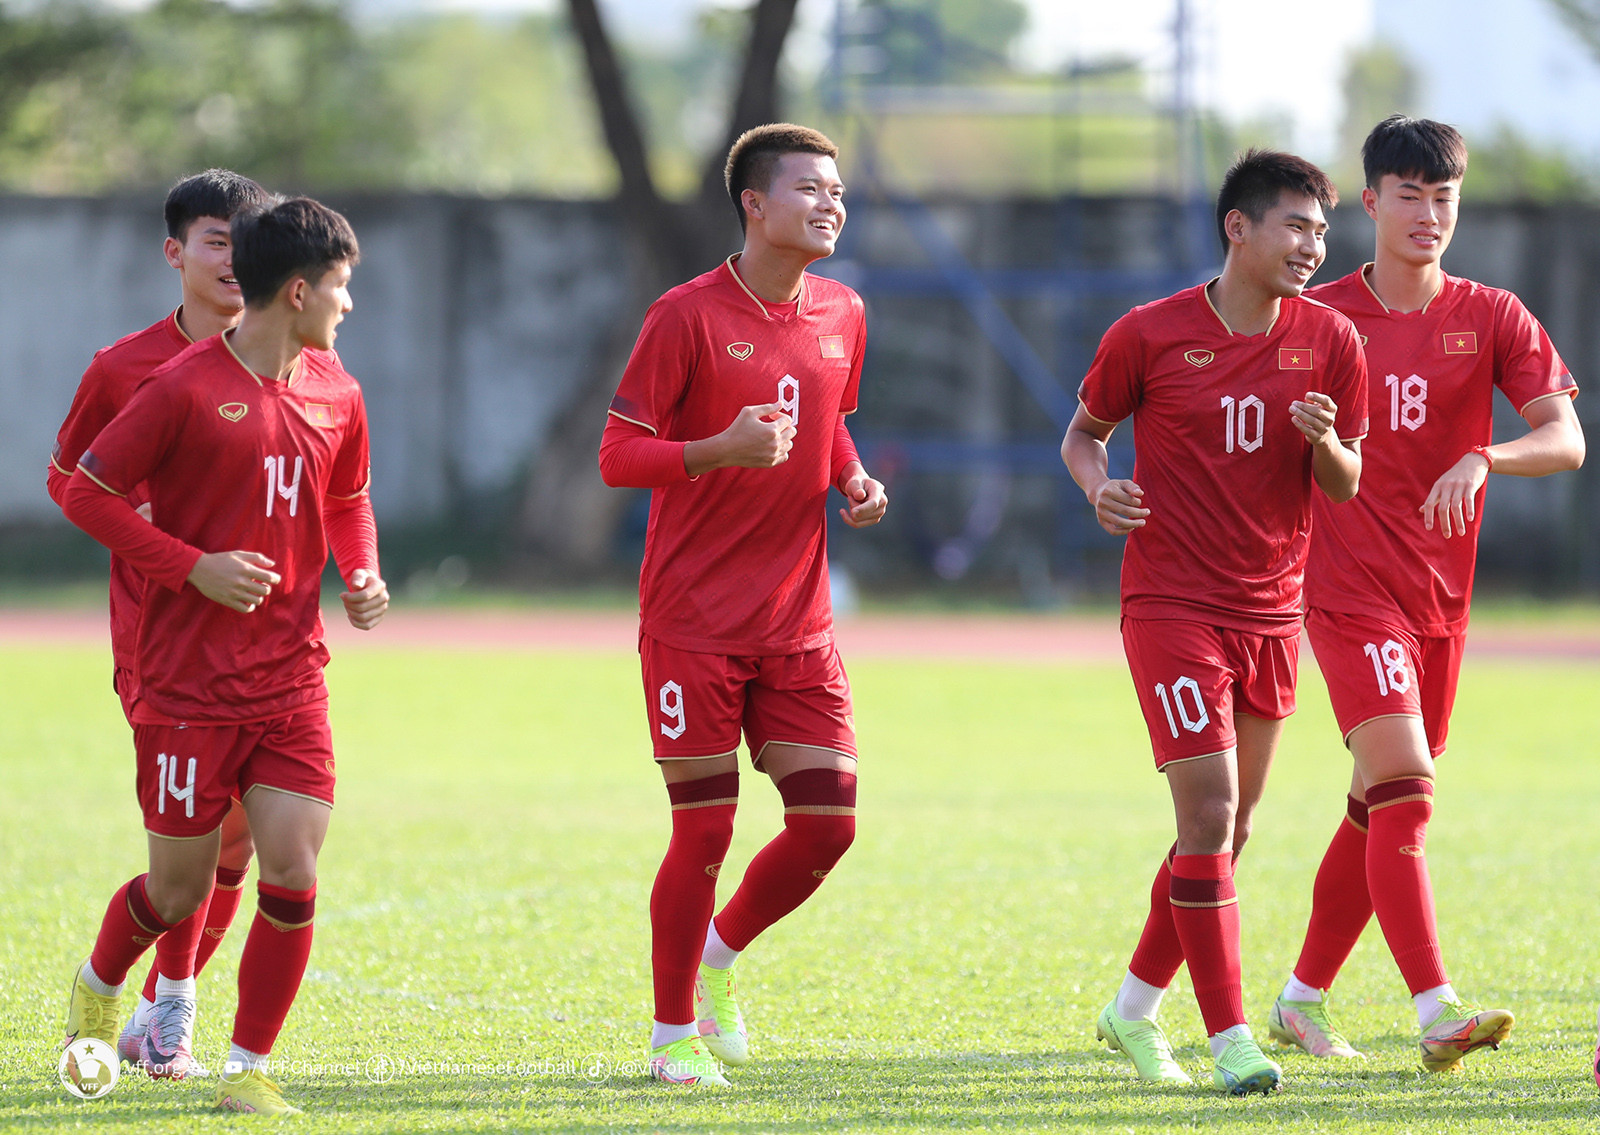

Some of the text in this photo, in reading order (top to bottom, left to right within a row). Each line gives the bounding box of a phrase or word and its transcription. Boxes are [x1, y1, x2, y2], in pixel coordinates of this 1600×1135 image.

[777, 373, 800, 427] 9
[1221, 394, 1265, 454] 10
[1385, 373, 1428, 432] 18
[264, 455, 302, 518] 14
[1363, 638, 1413, 698] 18
[659, 679, 687, 740] 9
[1154, 675, 1210, 739] 10
[156, 753, 197, 819] 14
